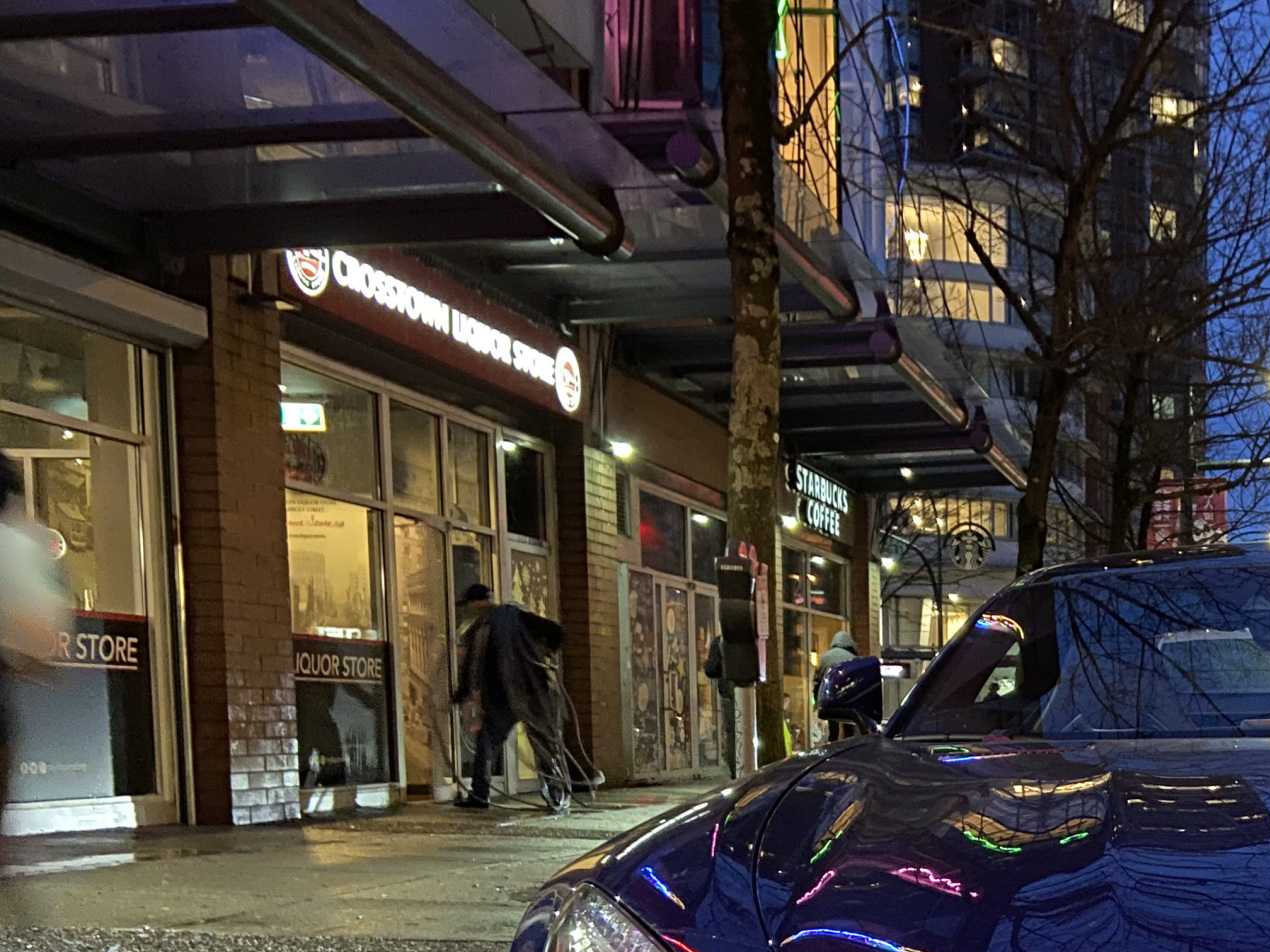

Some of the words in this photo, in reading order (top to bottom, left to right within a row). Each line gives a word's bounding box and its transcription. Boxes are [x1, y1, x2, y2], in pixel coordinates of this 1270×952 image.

[331, 250, 449, 334] CROSSTOWN
[512, 340, 555, 386] STORE
[796, 463, 849, 515] STARBUCKS
[807, 499, 840, 537] COFFEE
[75, 632, 139, 664] STORE
[295, 652, 341, 677] IQUOR
[342, 656, 383, 679] STORE
